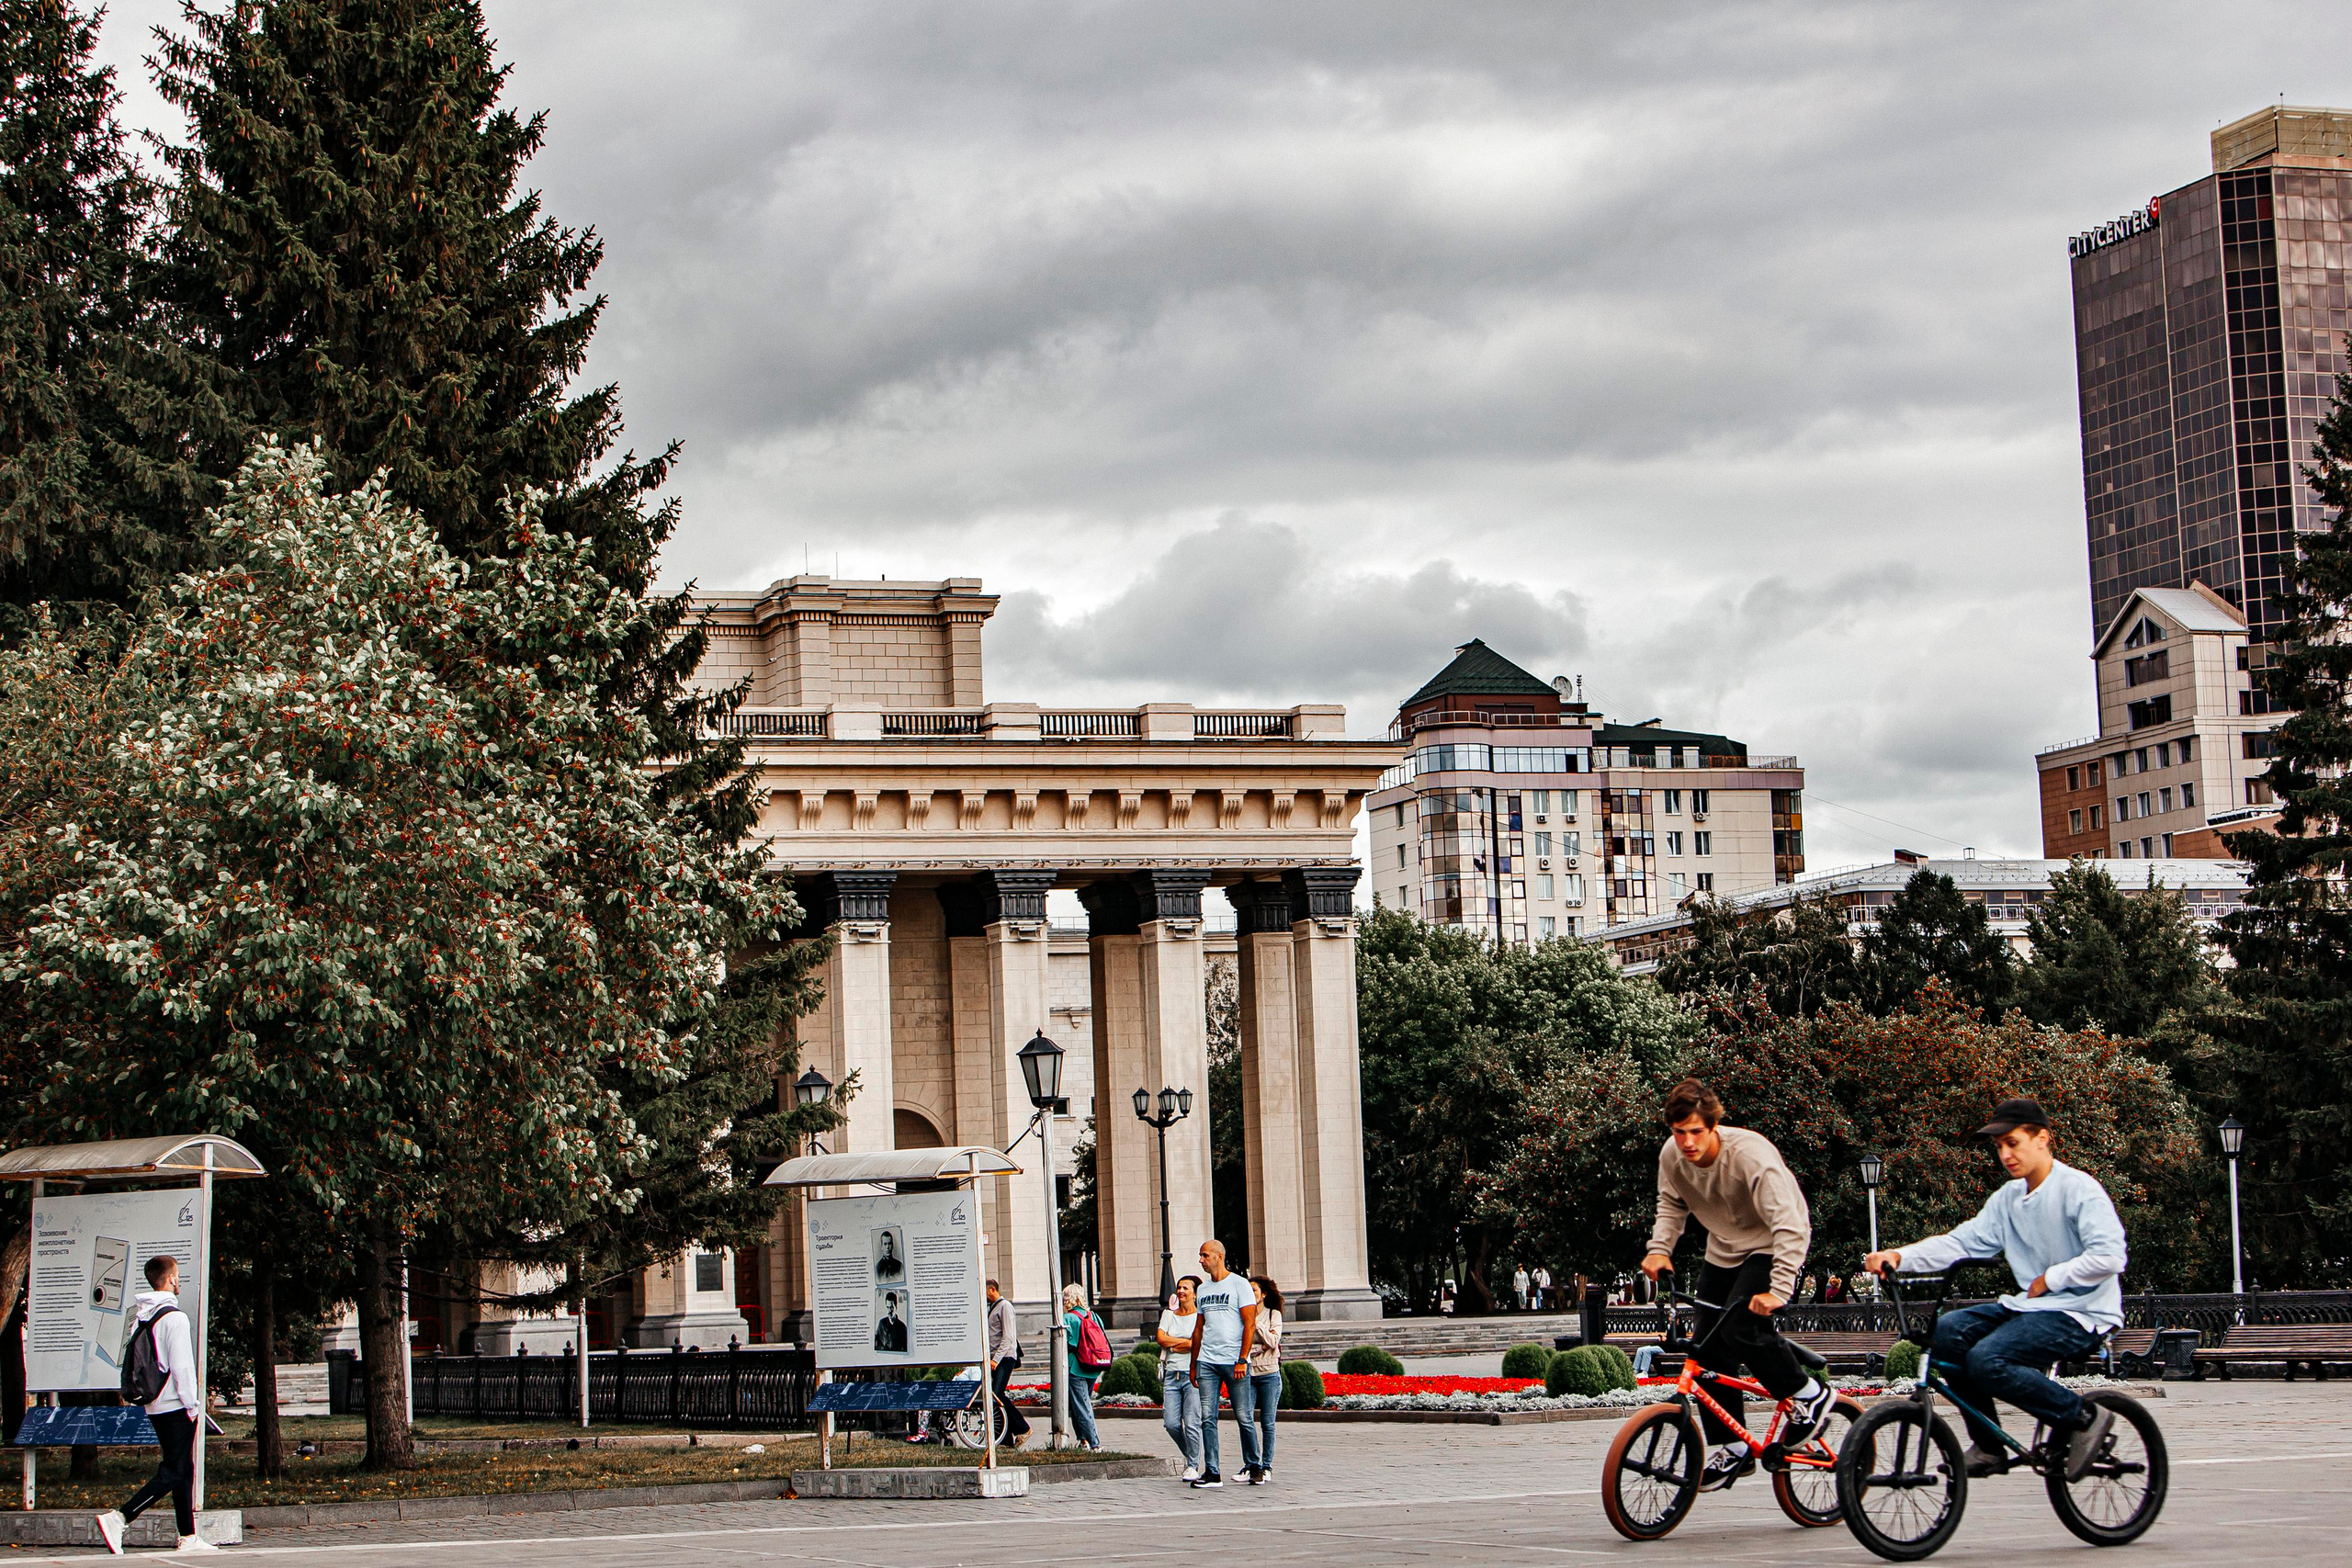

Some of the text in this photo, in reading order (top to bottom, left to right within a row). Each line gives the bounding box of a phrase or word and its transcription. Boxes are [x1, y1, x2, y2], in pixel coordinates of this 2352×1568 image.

[2067, 209, 2150, 258] CITYCENTER
[815, 1235, 843, 1243] Траектория
[815, 1242, 833, 1251] судьбы
[37, 1248, 70, 1258] пространств
